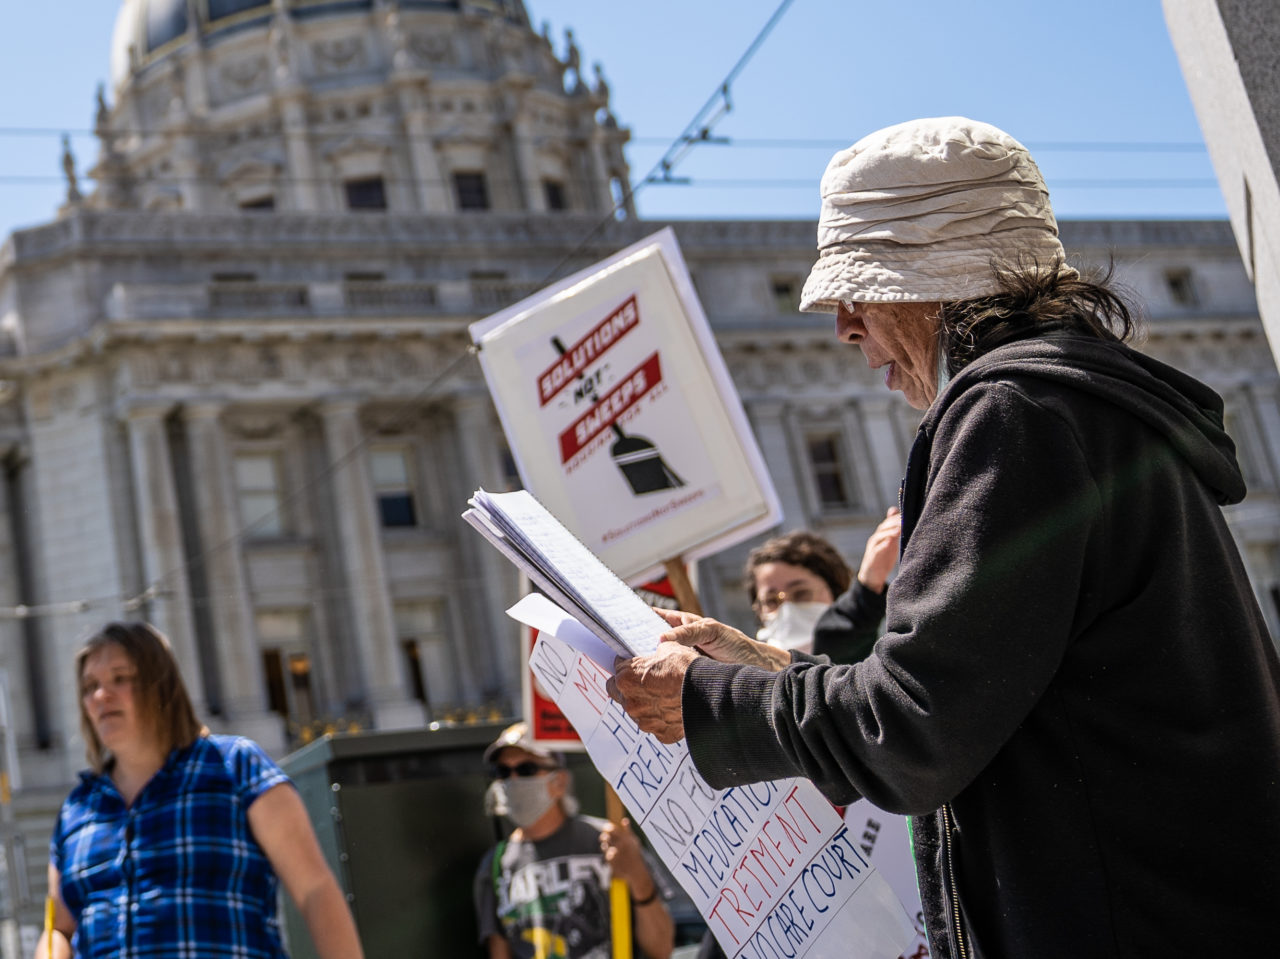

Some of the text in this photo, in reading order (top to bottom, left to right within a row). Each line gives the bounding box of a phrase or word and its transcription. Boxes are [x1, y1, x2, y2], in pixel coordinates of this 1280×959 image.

[540, 299, 637, 399] SOLUTIONS
[573, 369, 604, 404] NOT
[574, 368, 648, 446] SWEEPS
[534, 640, 568, 695] NO
[649, 798, 695, 859] NO
[681, 781, 778, 900] MEDICATIO
[709, 785, 821, 945] TRETMENT
[767, 889, 815, 959] CARE
[800, 827, 869, 913] COURT
